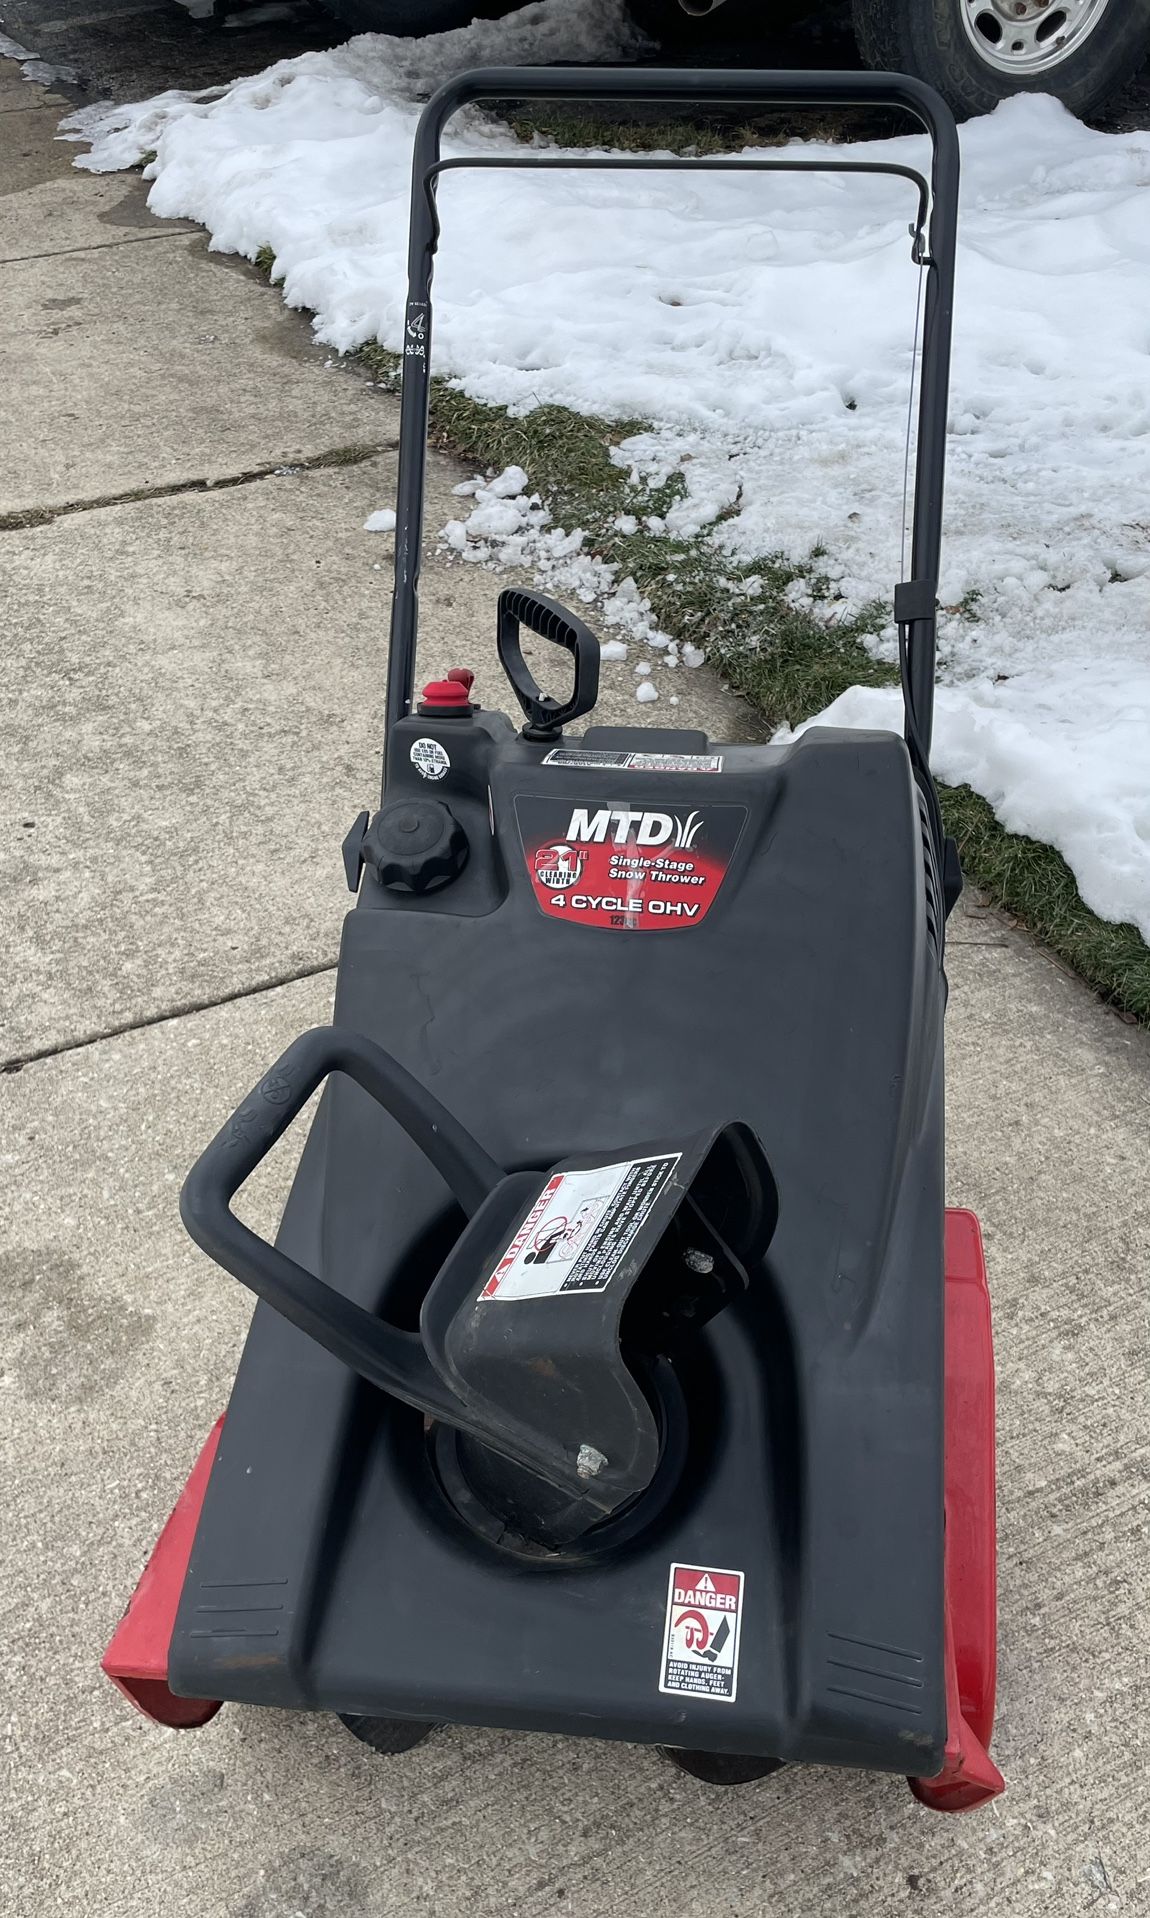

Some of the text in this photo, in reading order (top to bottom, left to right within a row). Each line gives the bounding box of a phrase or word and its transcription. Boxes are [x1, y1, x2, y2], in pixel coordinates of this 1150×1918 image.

[566, 808, 674, 845] MTD
[610, 855, 694, 871] Single-Stage
[608, 868, 705, 885] Snow Thrower
[550, 894, 699, 917] 4 CYCLE OHV
[507, 1188, 555, 1258] DANGER
[674, 1588, 736, 1610] DANGER
[668, 1668, 700, 1678] ROTATING
[669, 1661, 732, 1674] AVOID INJURY FROM
[667, 1680, 730, 1695] AND CLOTHING AWAY.
[668, 1674, 684, 1682] KEEP
[710, 1680, 724, 1688] FEET
